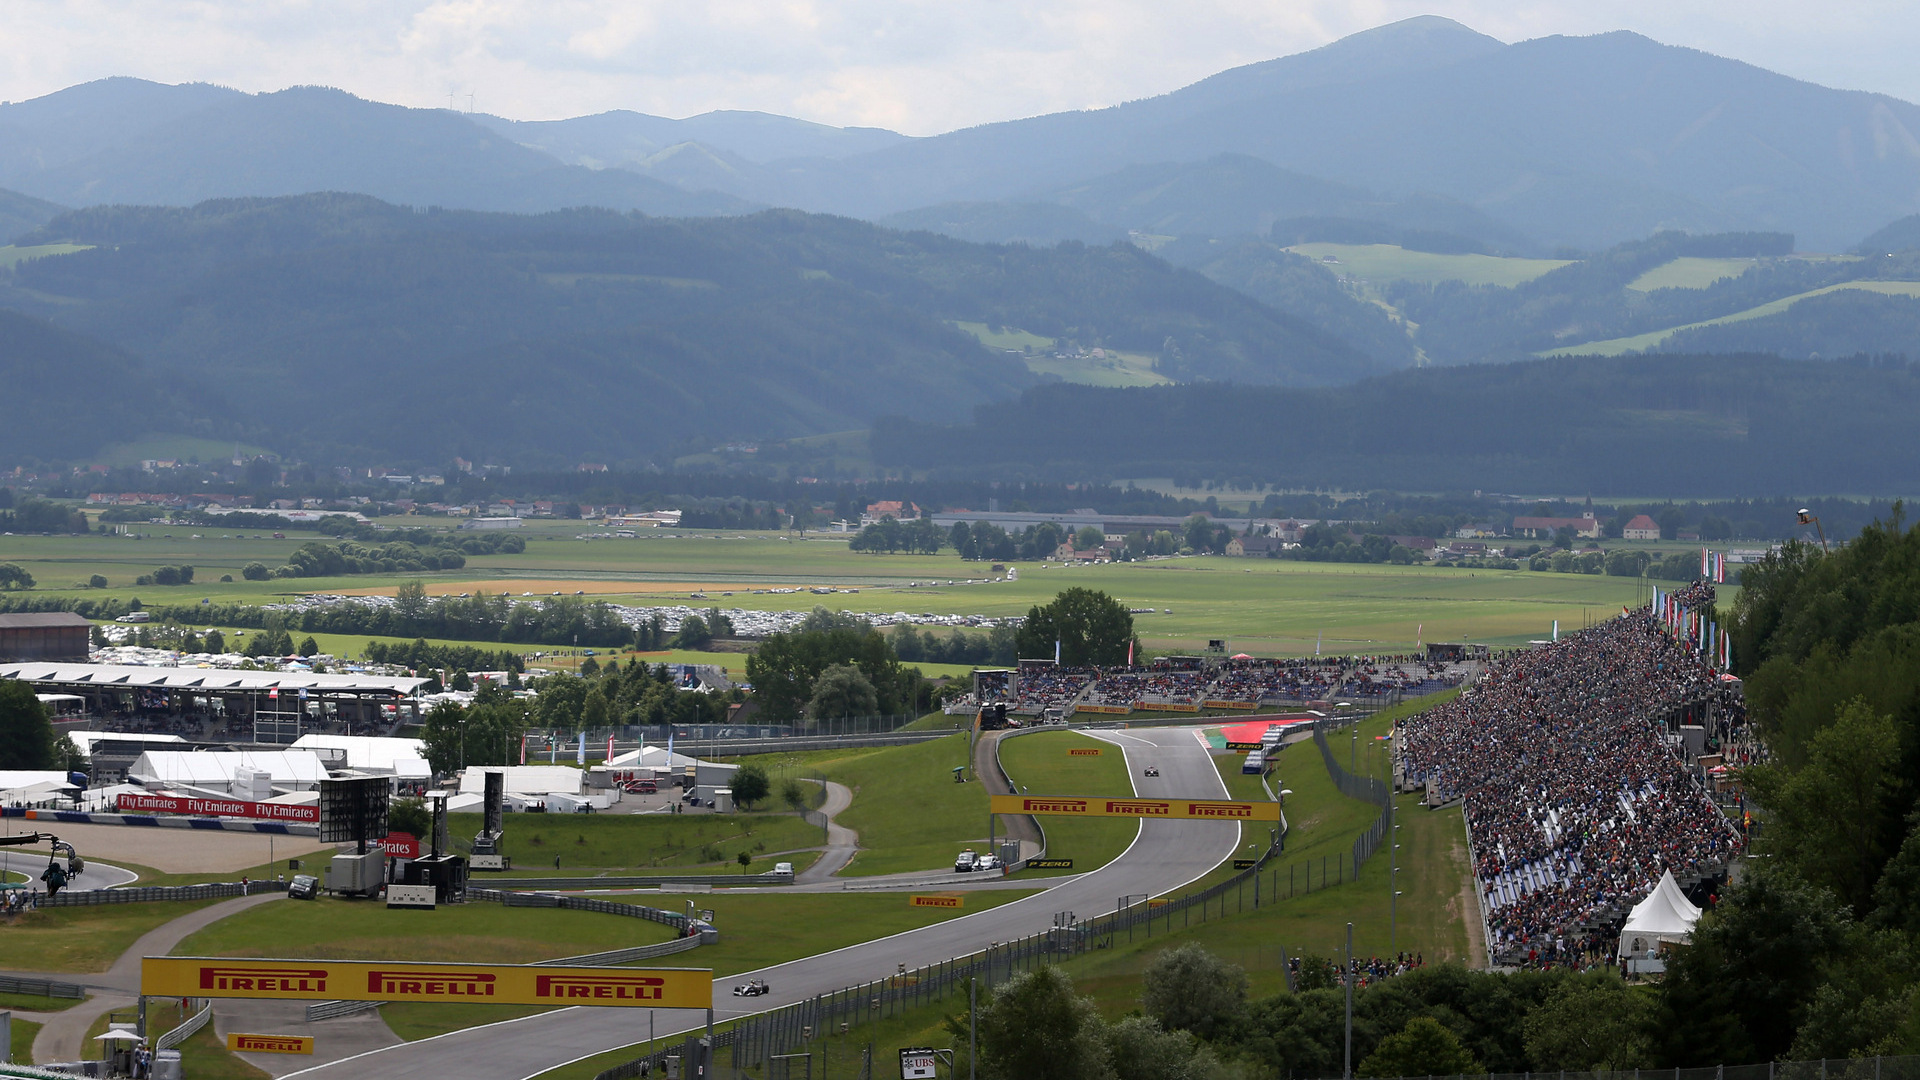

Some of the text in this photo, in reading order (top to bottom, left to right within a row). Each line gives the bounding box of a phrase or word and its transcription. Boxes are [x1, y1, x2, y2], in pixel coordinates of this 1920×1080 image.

[120, 795, 177, 809] Fly Emirates
[188, 799, 244, 814] Fly Emirates
[1023, 799, 1087, 812] PIRELLI
[1106, 801, 1169, 815] PIRELLI
[256, 804, 314, 819] Fly Emirates
[1189, 803, 1252, 817] PIRELLI
[916, 897, 957, 907] PIRELLI
[200, 967, 328, 992] PIRELLI
[368, 971, 496, 996] PIRELLI
[536, 975, 664, 1000] PIRELLI
[237, 1036, 303, 1052] PIRELLI
[915, 1058, 935, 1068] UBS
